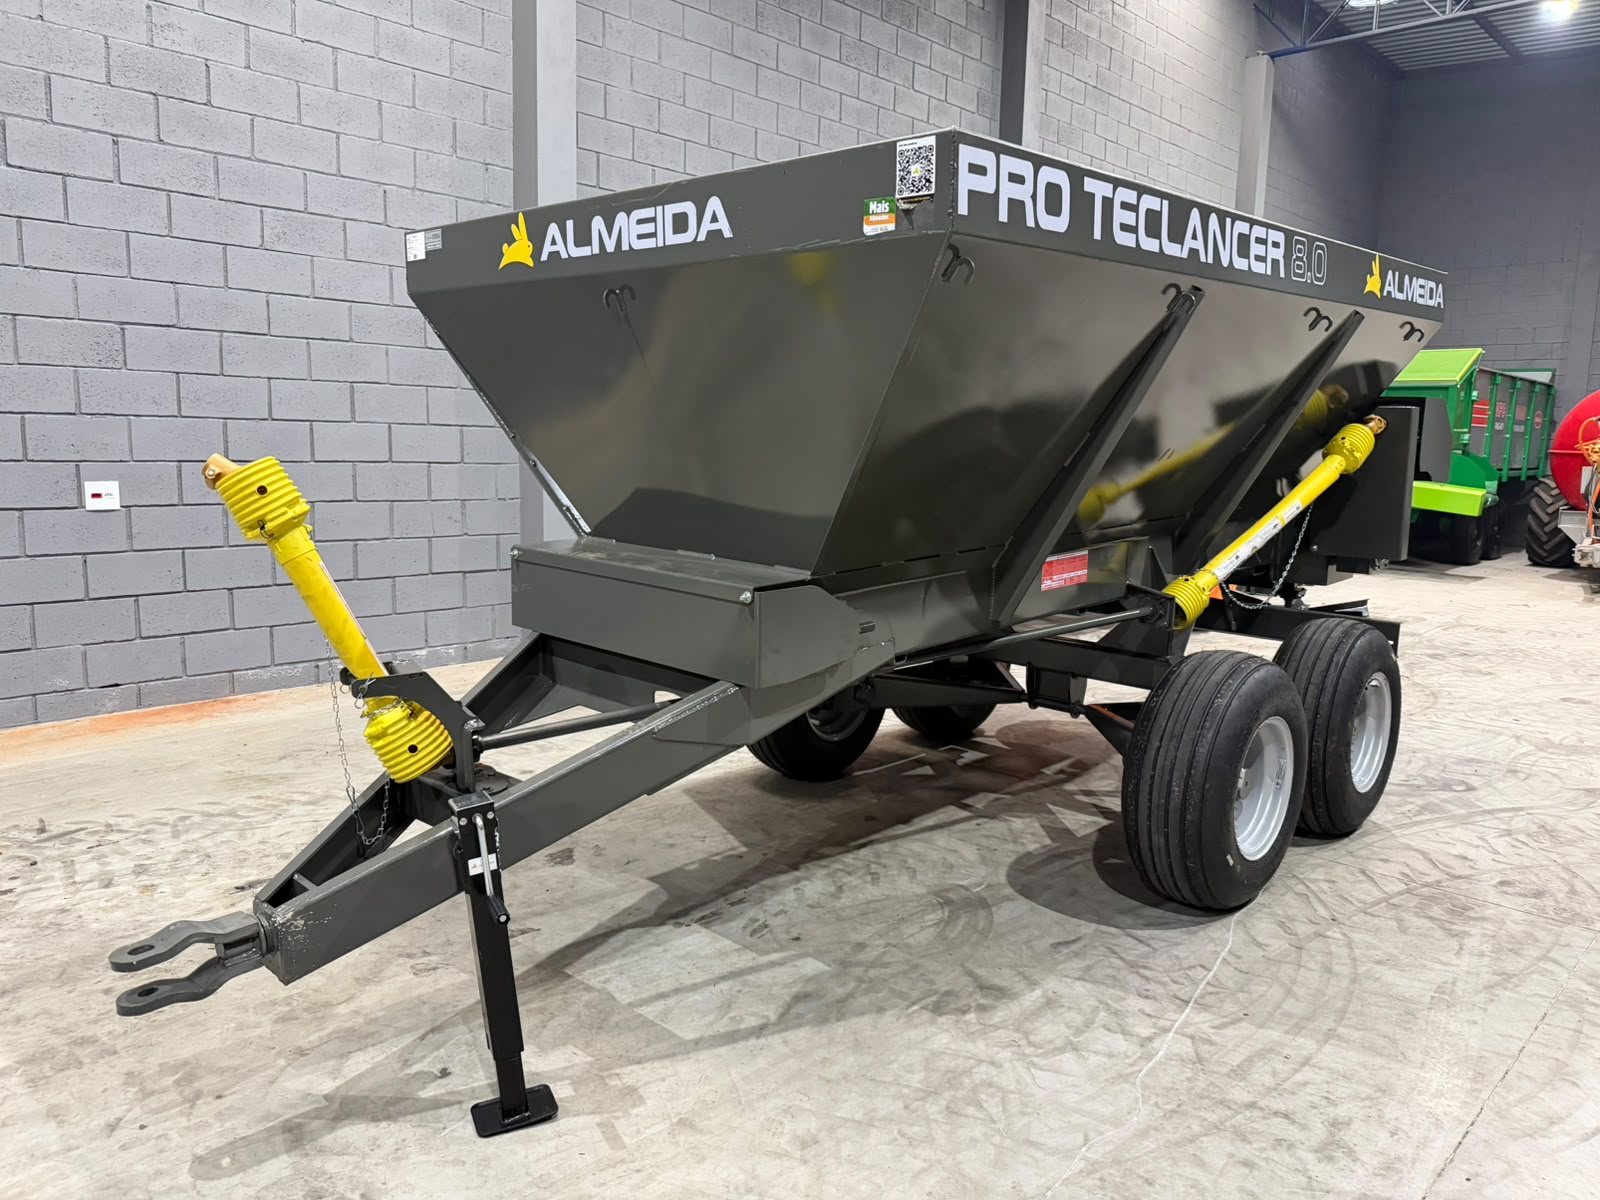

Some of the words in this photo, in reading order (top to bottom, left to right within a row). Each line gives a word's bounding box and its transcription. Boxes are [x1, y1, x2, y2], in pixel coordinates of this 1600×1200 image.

[540, 195, 734, 262] ALMEIDA
[869, 200, 890, 214] Mais
[957, 142, 1071, 233] PRO
[1083, 176, 1286, 278] TECLANCER
[1291, 235, 1328, 286] 8.0
[1383, 269, 1444, 309] ALMEIDA
